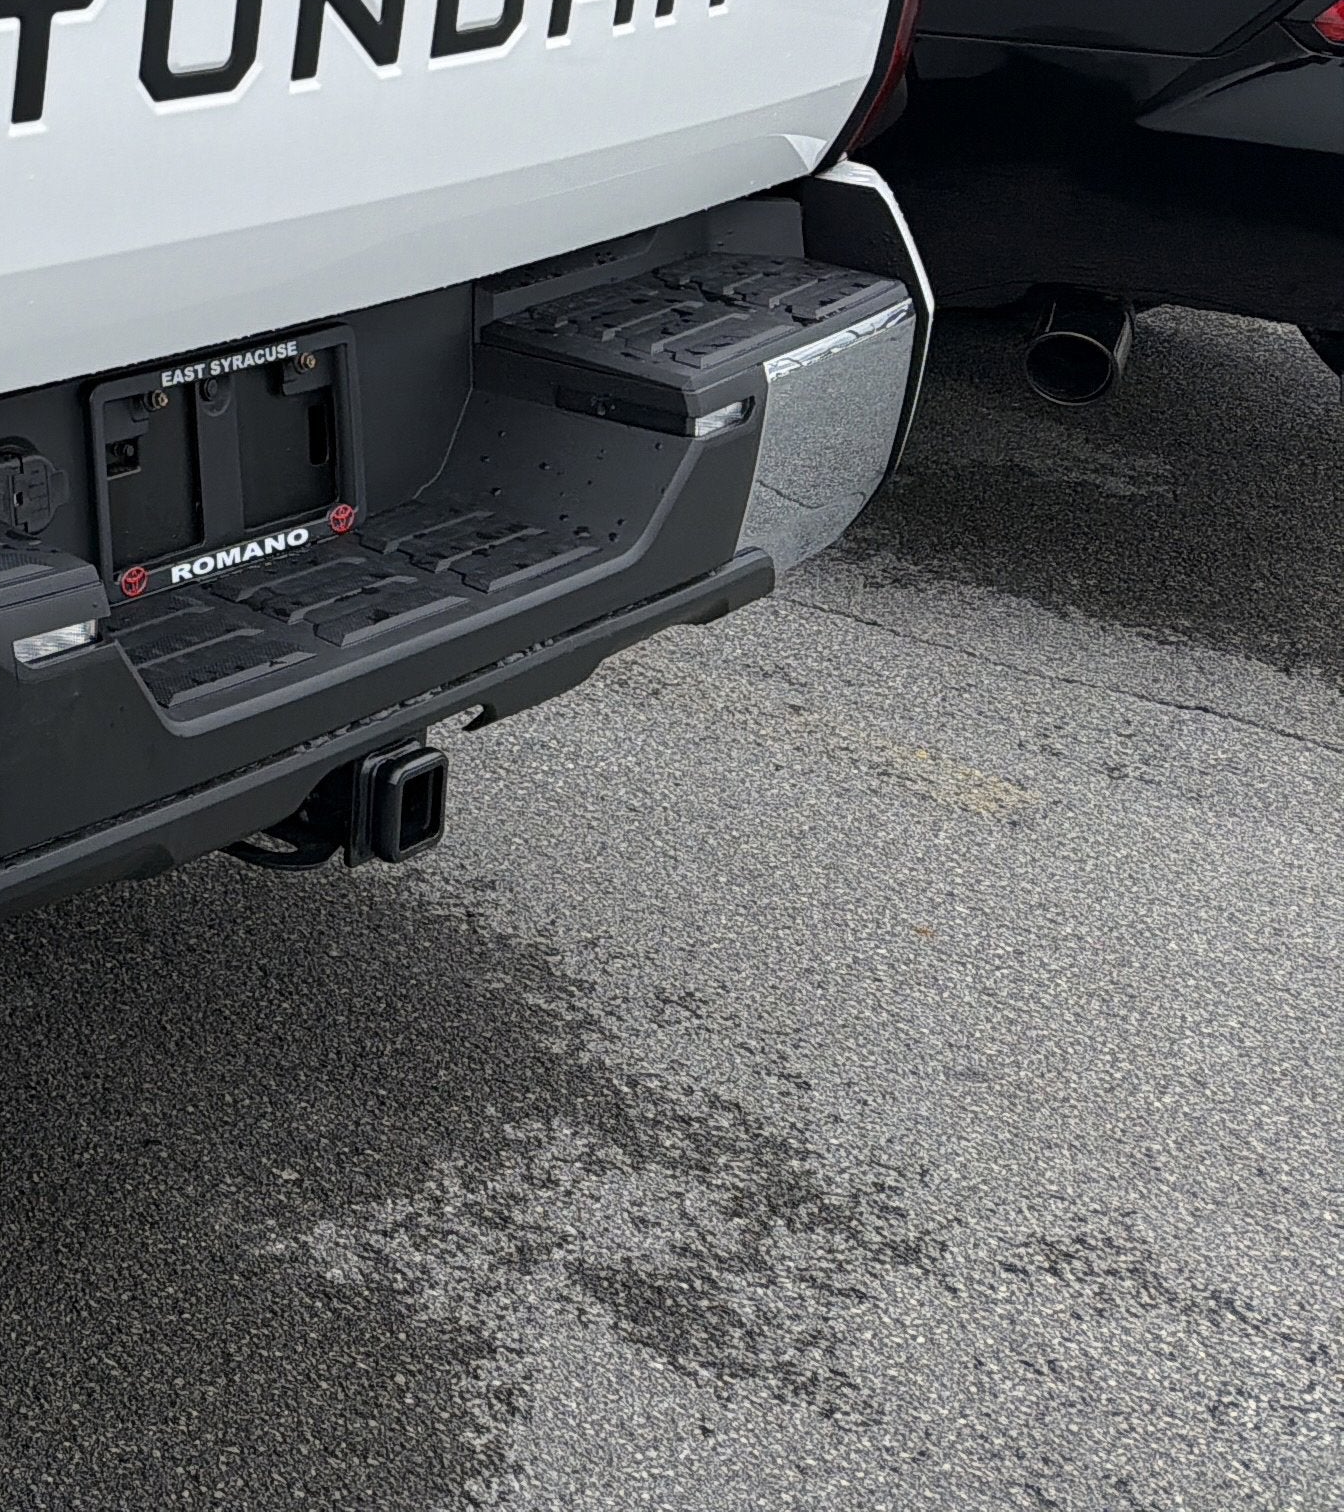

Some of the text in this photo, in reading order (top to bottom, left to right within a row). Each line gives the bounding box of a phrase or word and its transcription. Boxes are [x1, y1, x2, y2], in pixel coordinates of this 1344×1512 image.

[162, 341, 298, 388] EAST SYRACUSE
[171, 528, 309, 584] ROMANO
